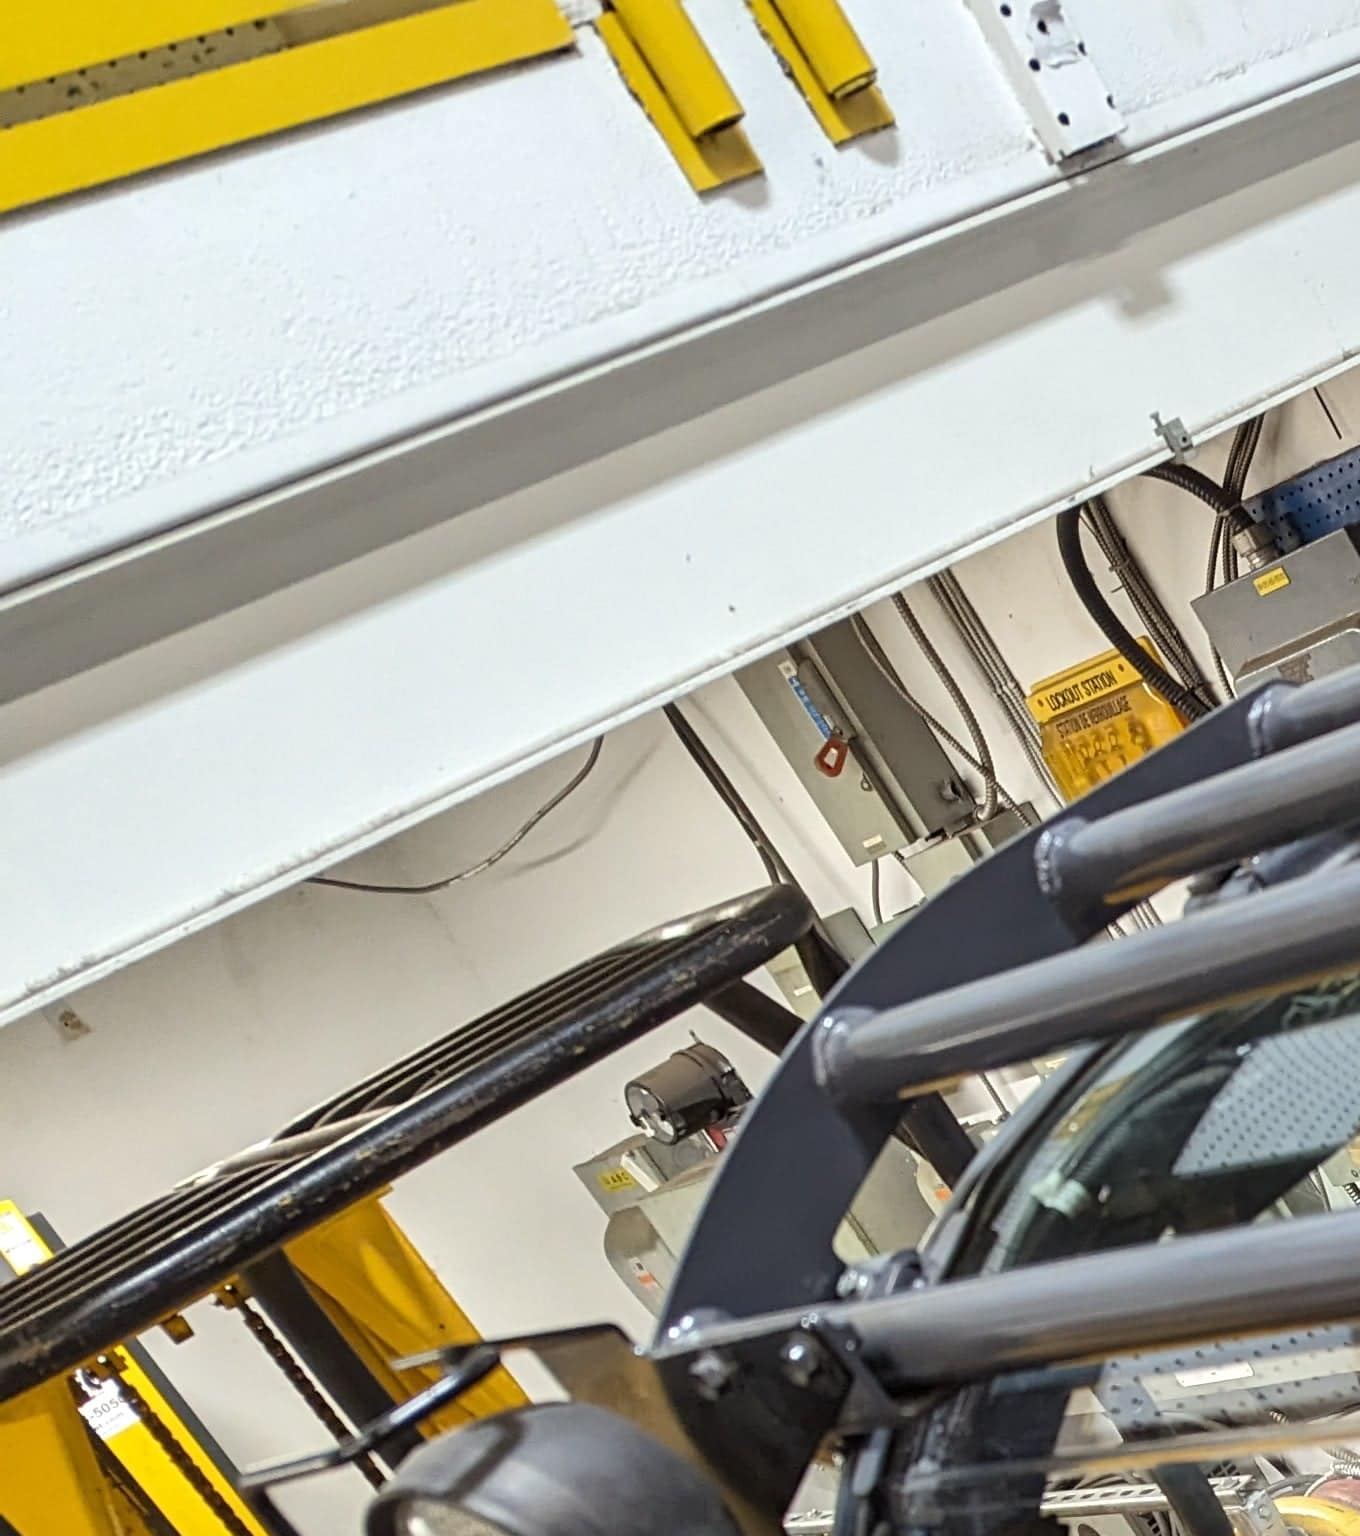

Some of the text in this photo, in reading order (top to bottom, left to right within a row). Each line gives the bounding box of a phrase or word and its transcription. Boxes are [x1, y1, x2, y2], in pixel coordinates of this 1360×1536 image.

[1045, 669, 1118, 711] LOCKOUT STATION
[1056, 694, 1132, 740] STATION DE VERROUILLAGE
